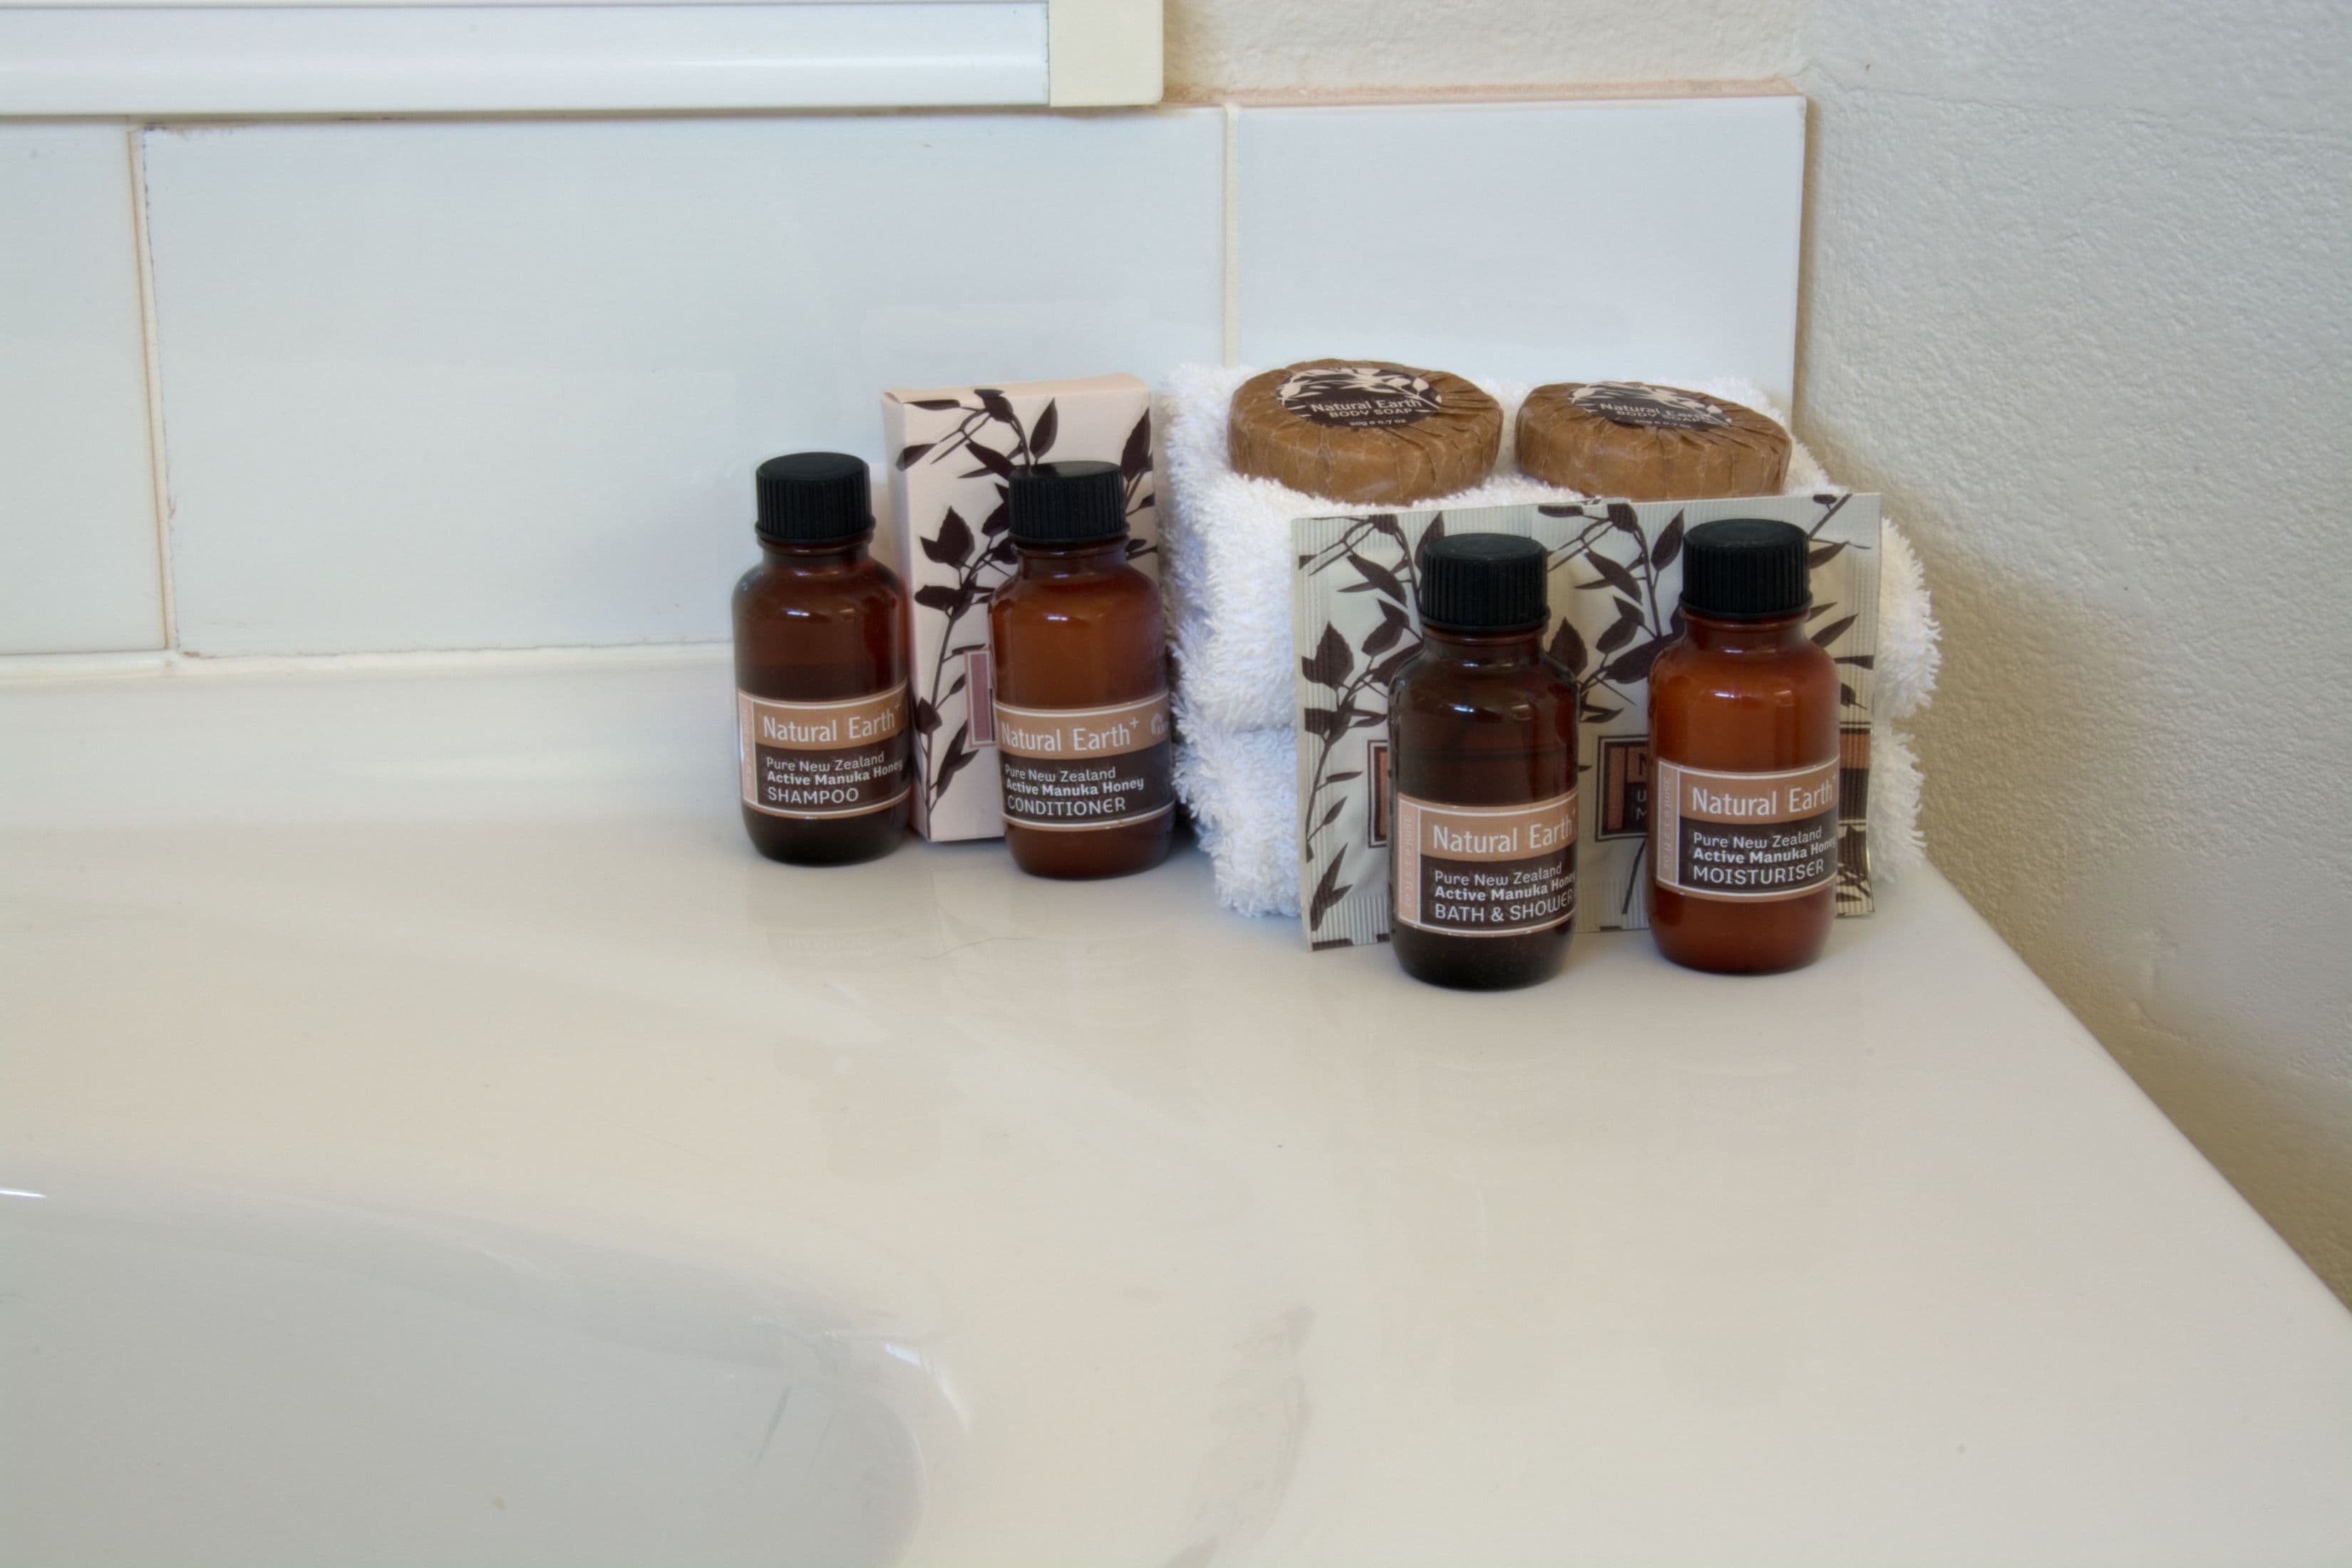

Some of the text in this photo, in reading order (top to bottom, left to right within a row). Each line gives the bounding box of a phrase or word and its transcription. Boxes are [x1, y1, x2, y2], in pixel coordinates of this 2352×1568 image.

[1311, 399, 1422, 412] Natural Earth
[1600, 403, 1661, 414] Natural
[763, 716, 837, 742] Natural
[1001, 722, 1062, 752] Natural
[766, 751, 884, 772] Pure New Zealand
[767, 759, 903, 785] Active Manuka Honey
[1005, 764, 1116, 783] Pure New Zealand
[768, 786, 859, 805] SHAMPOO
[1006, 777, 1145, 797] Active Manuka Honey
[1008, 795, 1126, 817] CONDITIONER
[1693, 787, 1778, 816] Natural
[1433, 825, 1517, 853] Natural
[1693, 826, 1822, 849] Pure New Zealand
[1693, 847, 1745, 864] Active
[1749, 847, 1807, 864] Manuka
[1435, 861, 1562, 887] Pure New Zealand
[1693, 858, 1824, 885] MOISTURISER
[1435, 886, 1487, 902] Active
[1491, 883, 1548, 901] Manuka
[1435, 888, 1574, 922] BATH & SHOWER
